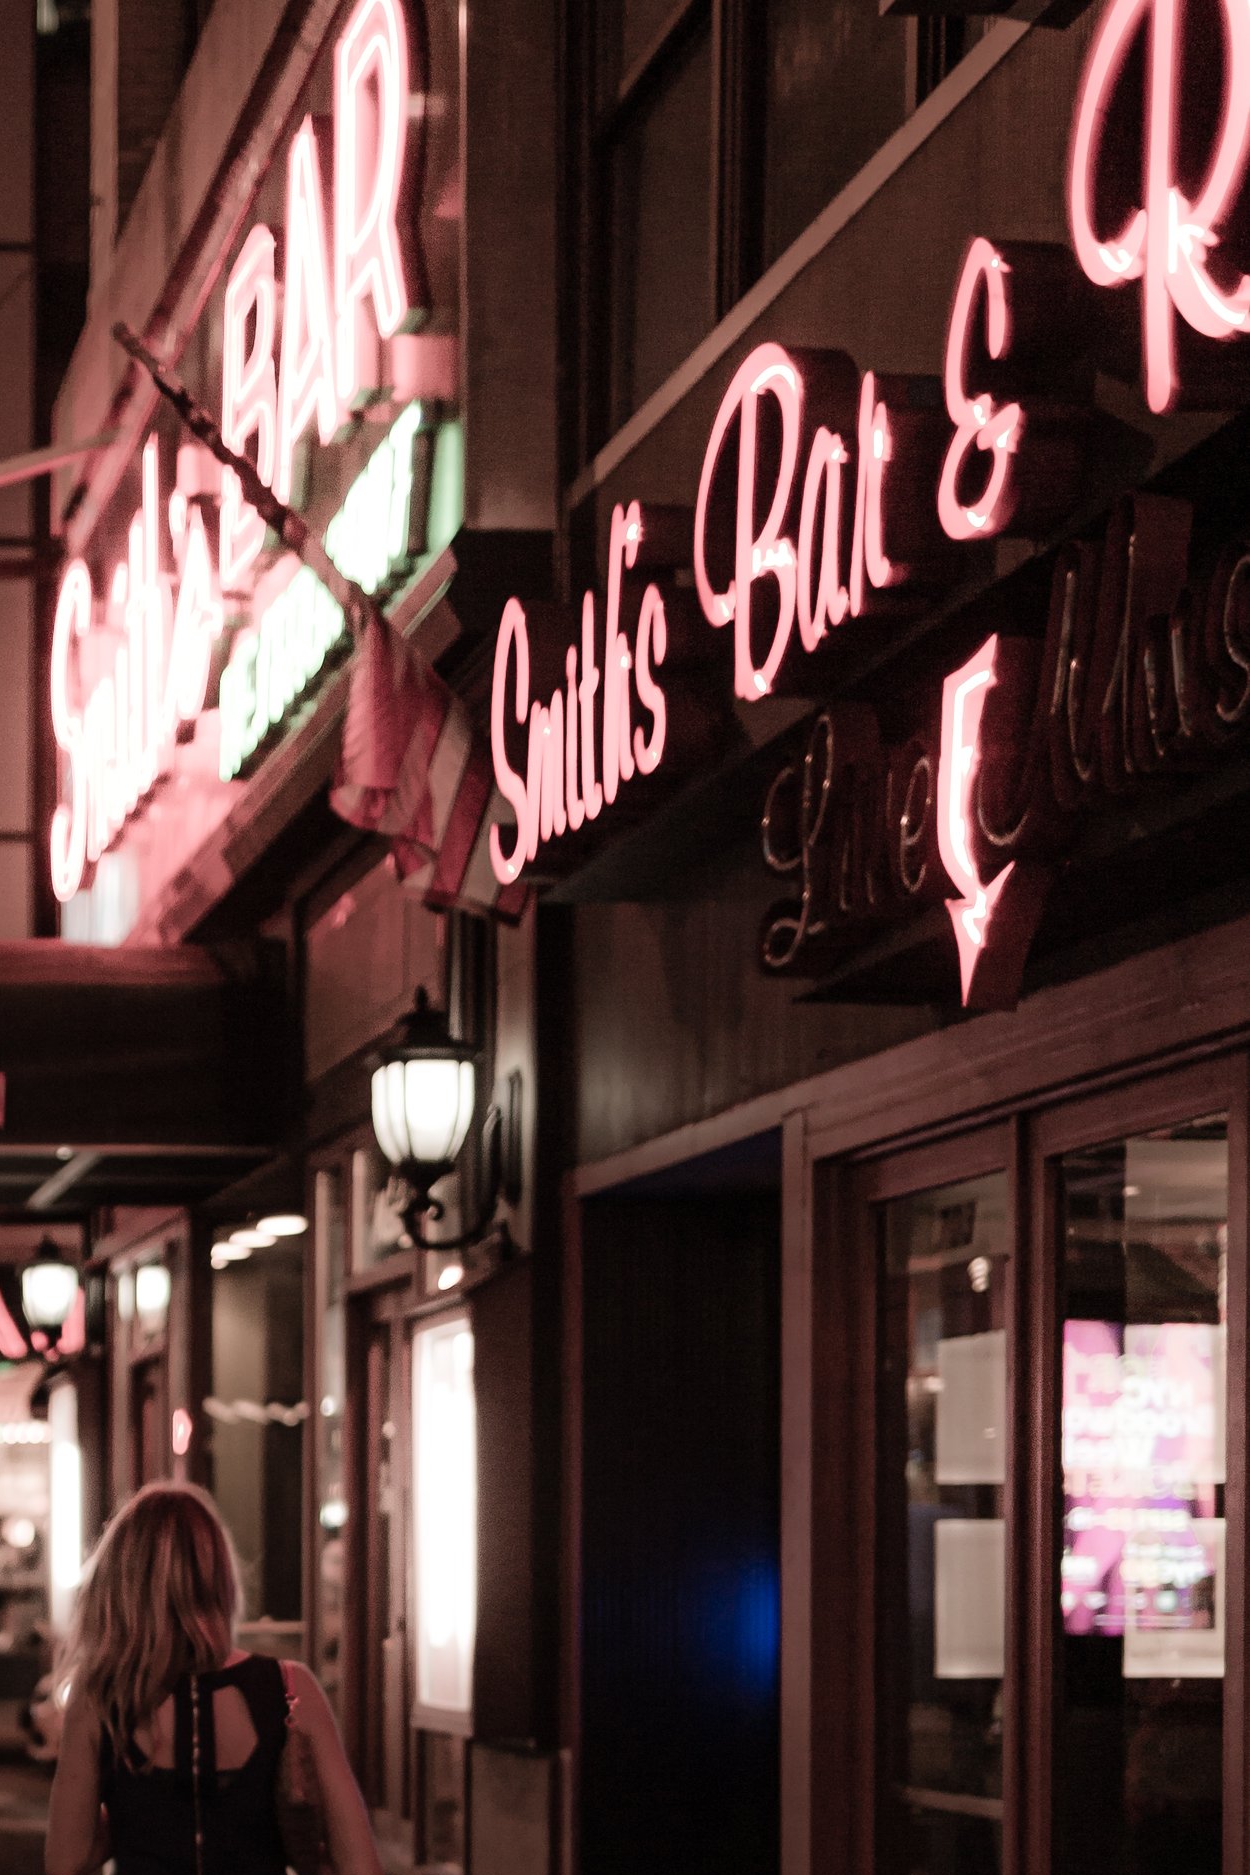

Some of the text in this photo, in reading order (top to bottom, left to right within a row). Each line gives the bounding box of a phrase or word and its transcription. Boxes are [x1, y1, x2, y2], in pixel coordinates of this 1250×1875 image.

[220, 0, 408, 590] BAR
[490, 499, 667, 885] Smith's
[694, 341, 892, 701] Bar
[937, 236, 1024, 541] &
